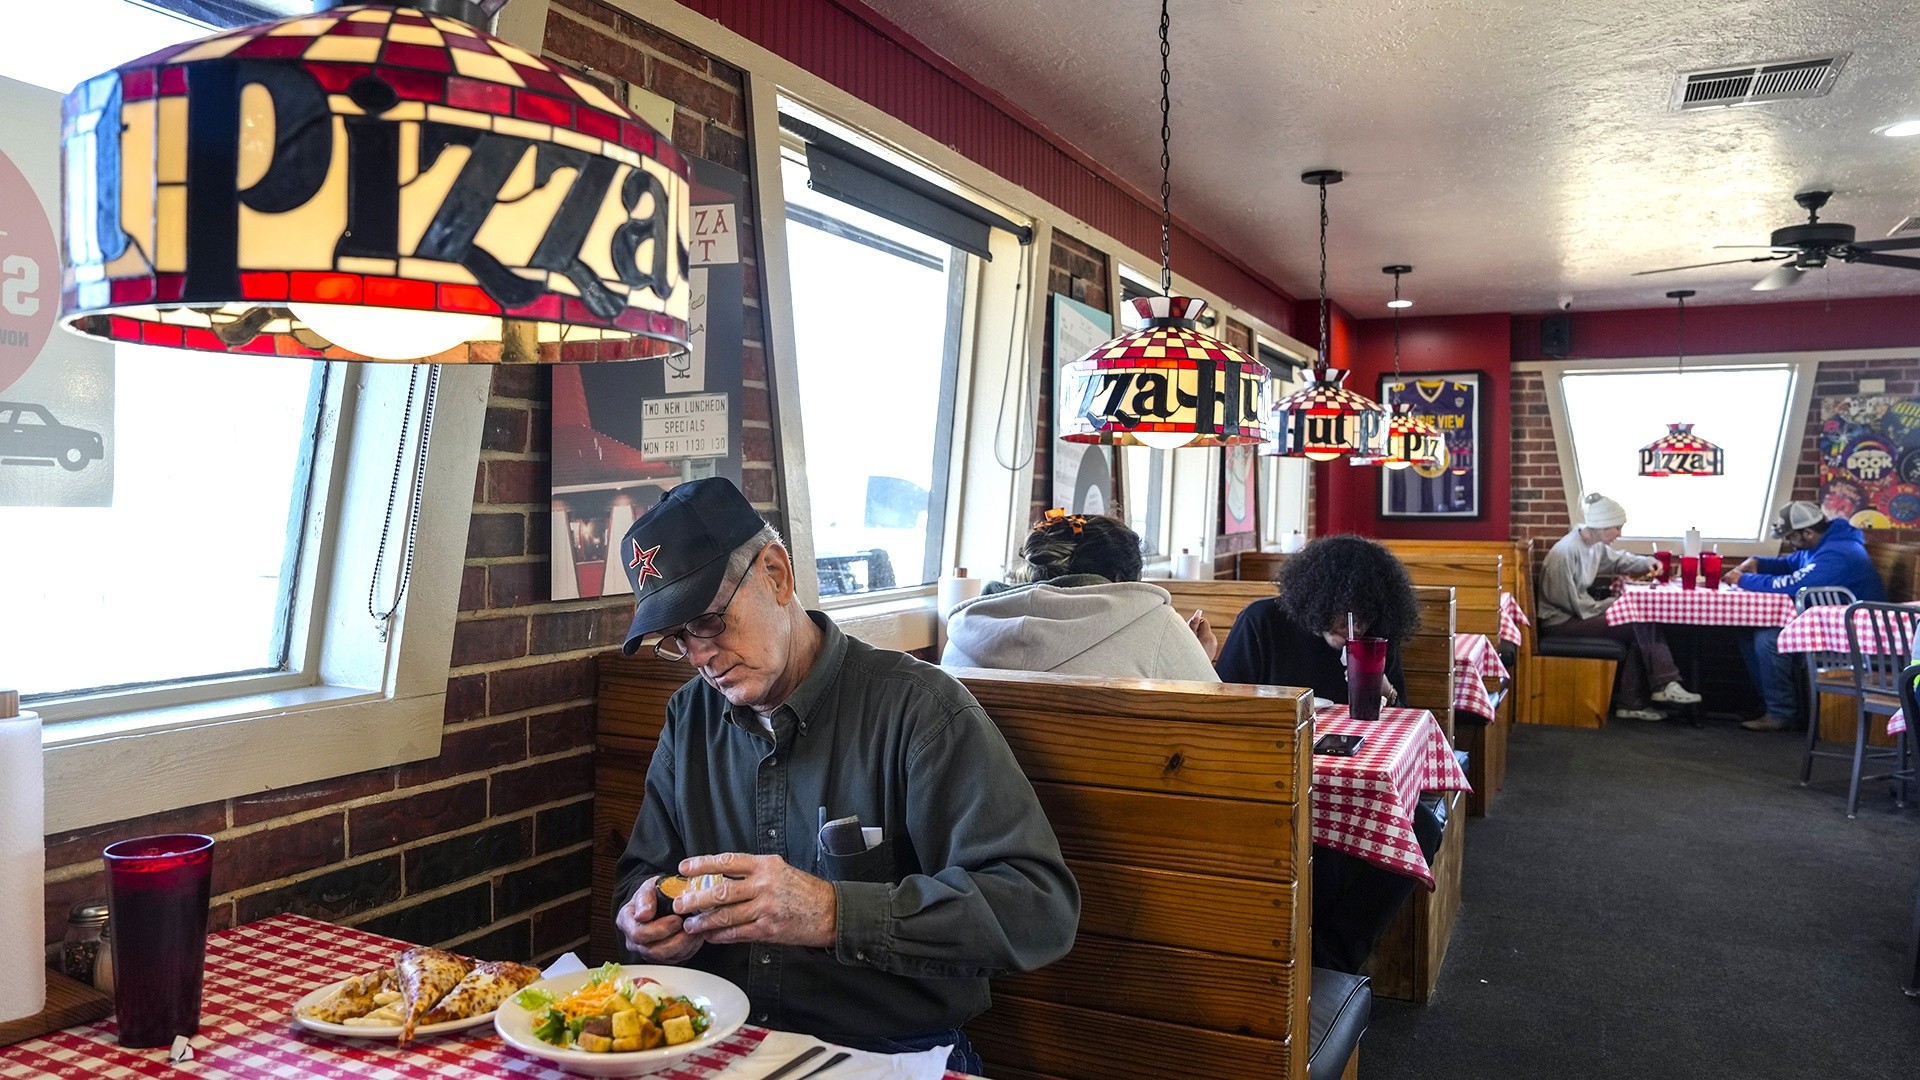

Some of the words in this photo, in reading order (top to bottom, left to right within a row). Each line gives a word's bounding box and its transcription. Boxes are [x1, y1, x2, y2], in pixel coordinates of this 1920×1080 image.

[185, 58, 672, 318] Pizza
[644, 403, 659, 416] TWO
[664, 401, 680, 415] NEW
[684, 399, 726, 414] LUNCHEON
[664, 419, 705, 434] SPECIALS
[1437, 413, 1466, 430] VIEW
[643, 442, 660, 455] MON
[664, 440, 679, 453] FRI
[685, 438, 705, 452] 1130
[1640, 448, 1705, 476] Pizza
[1846, 455, 1893, 471] BOOK
